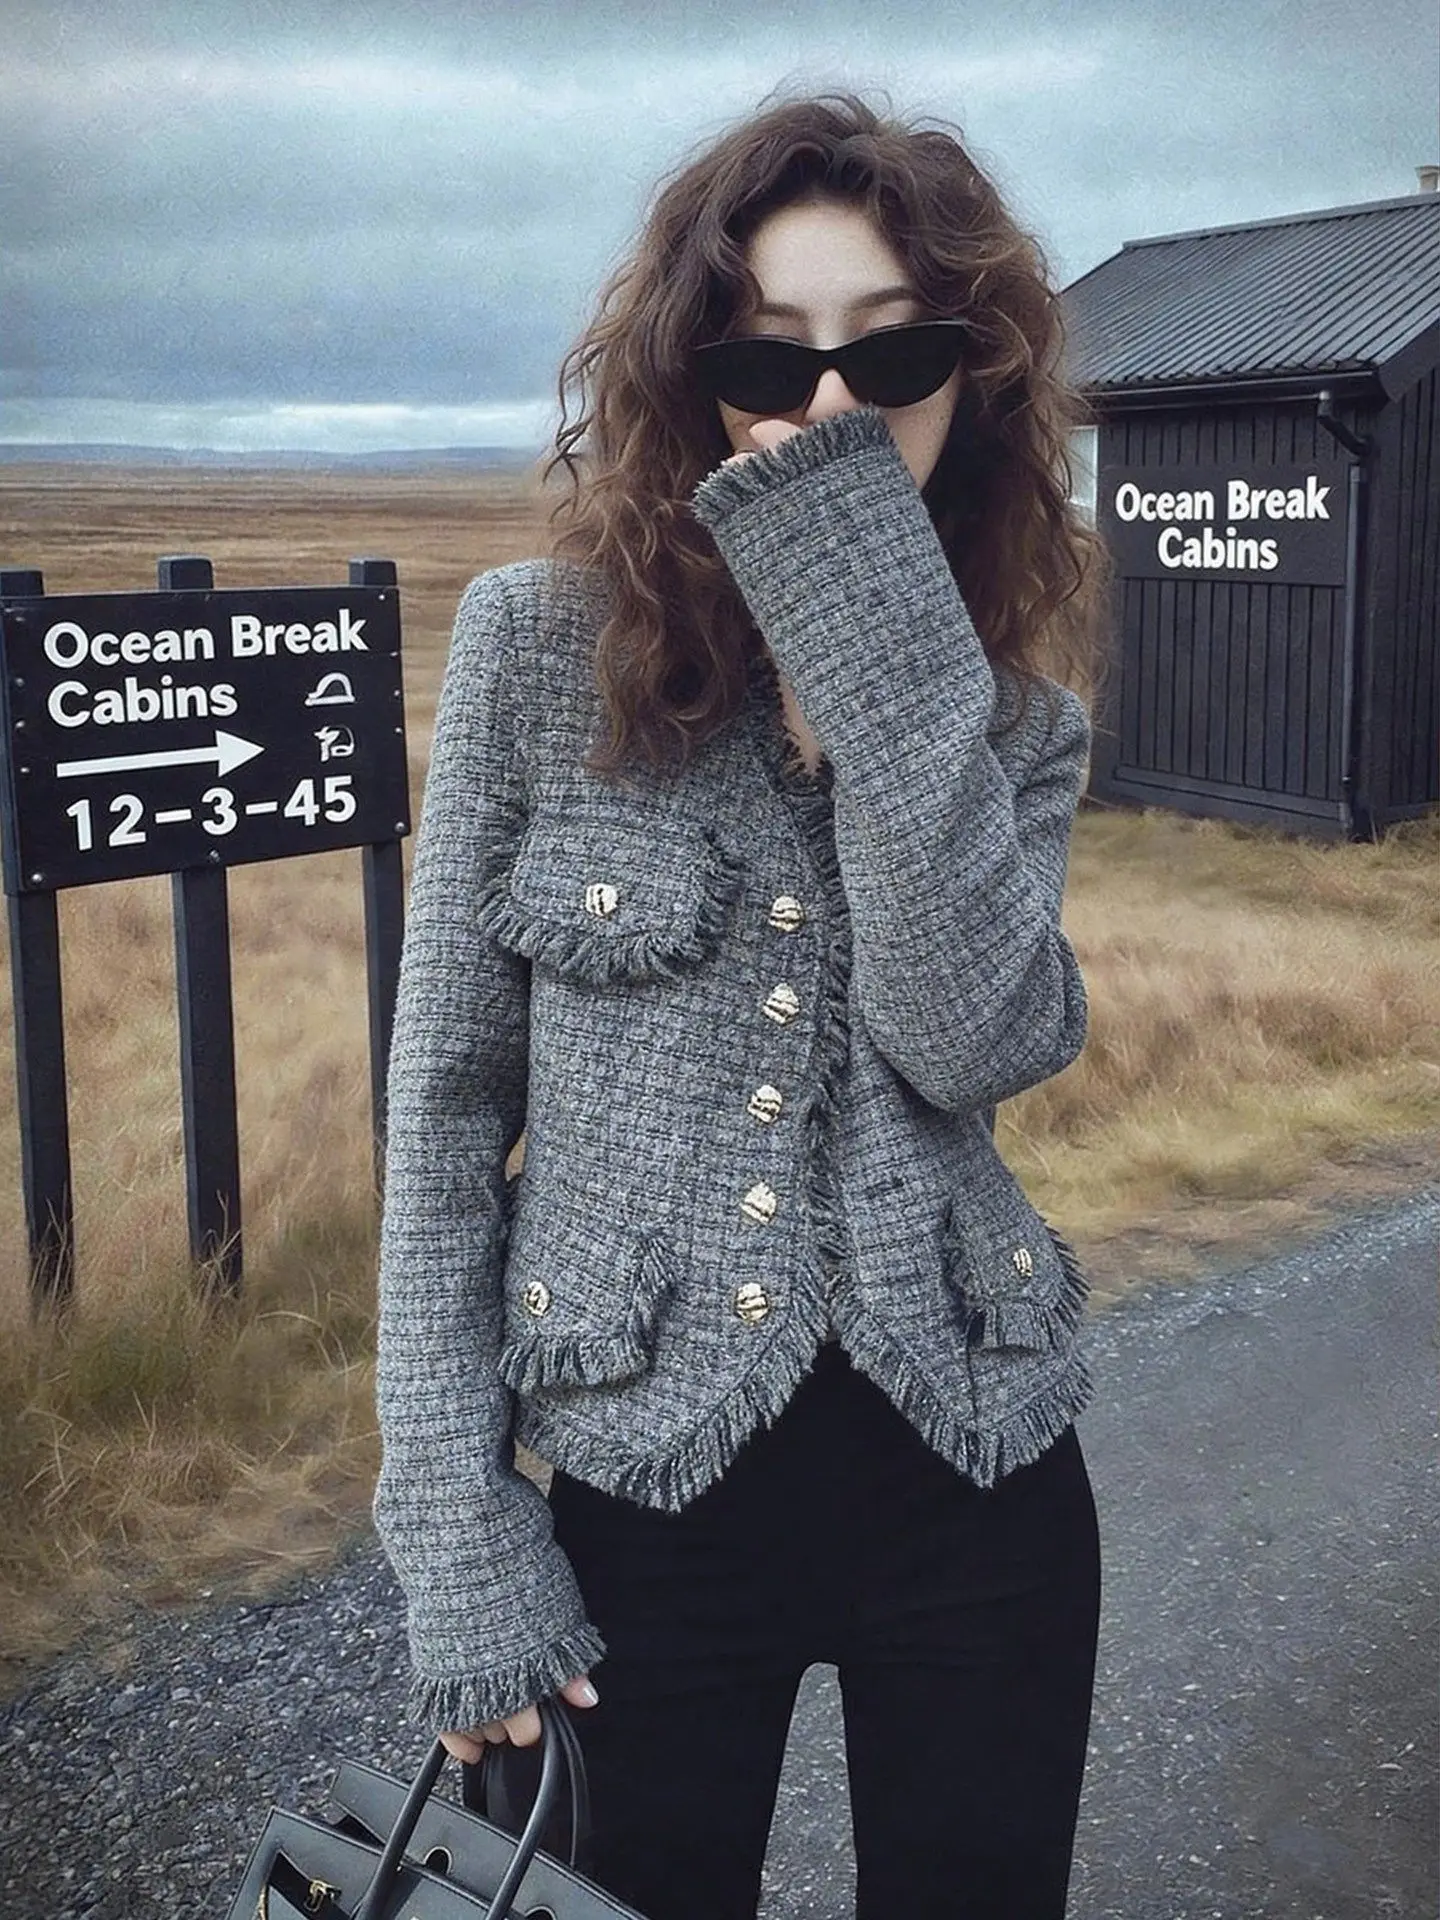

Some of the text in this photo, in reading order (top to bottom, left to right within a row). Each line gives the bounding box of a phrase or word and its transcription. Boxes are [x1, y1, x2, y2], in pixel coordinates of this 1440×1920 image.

[1115, 475, 1331, 521] Ocean Break
[1157, 526, 1279, 570] Cabins
[43, 608, 369, 668] Ocean Break
[47, 674, 238, 727] Cabins
